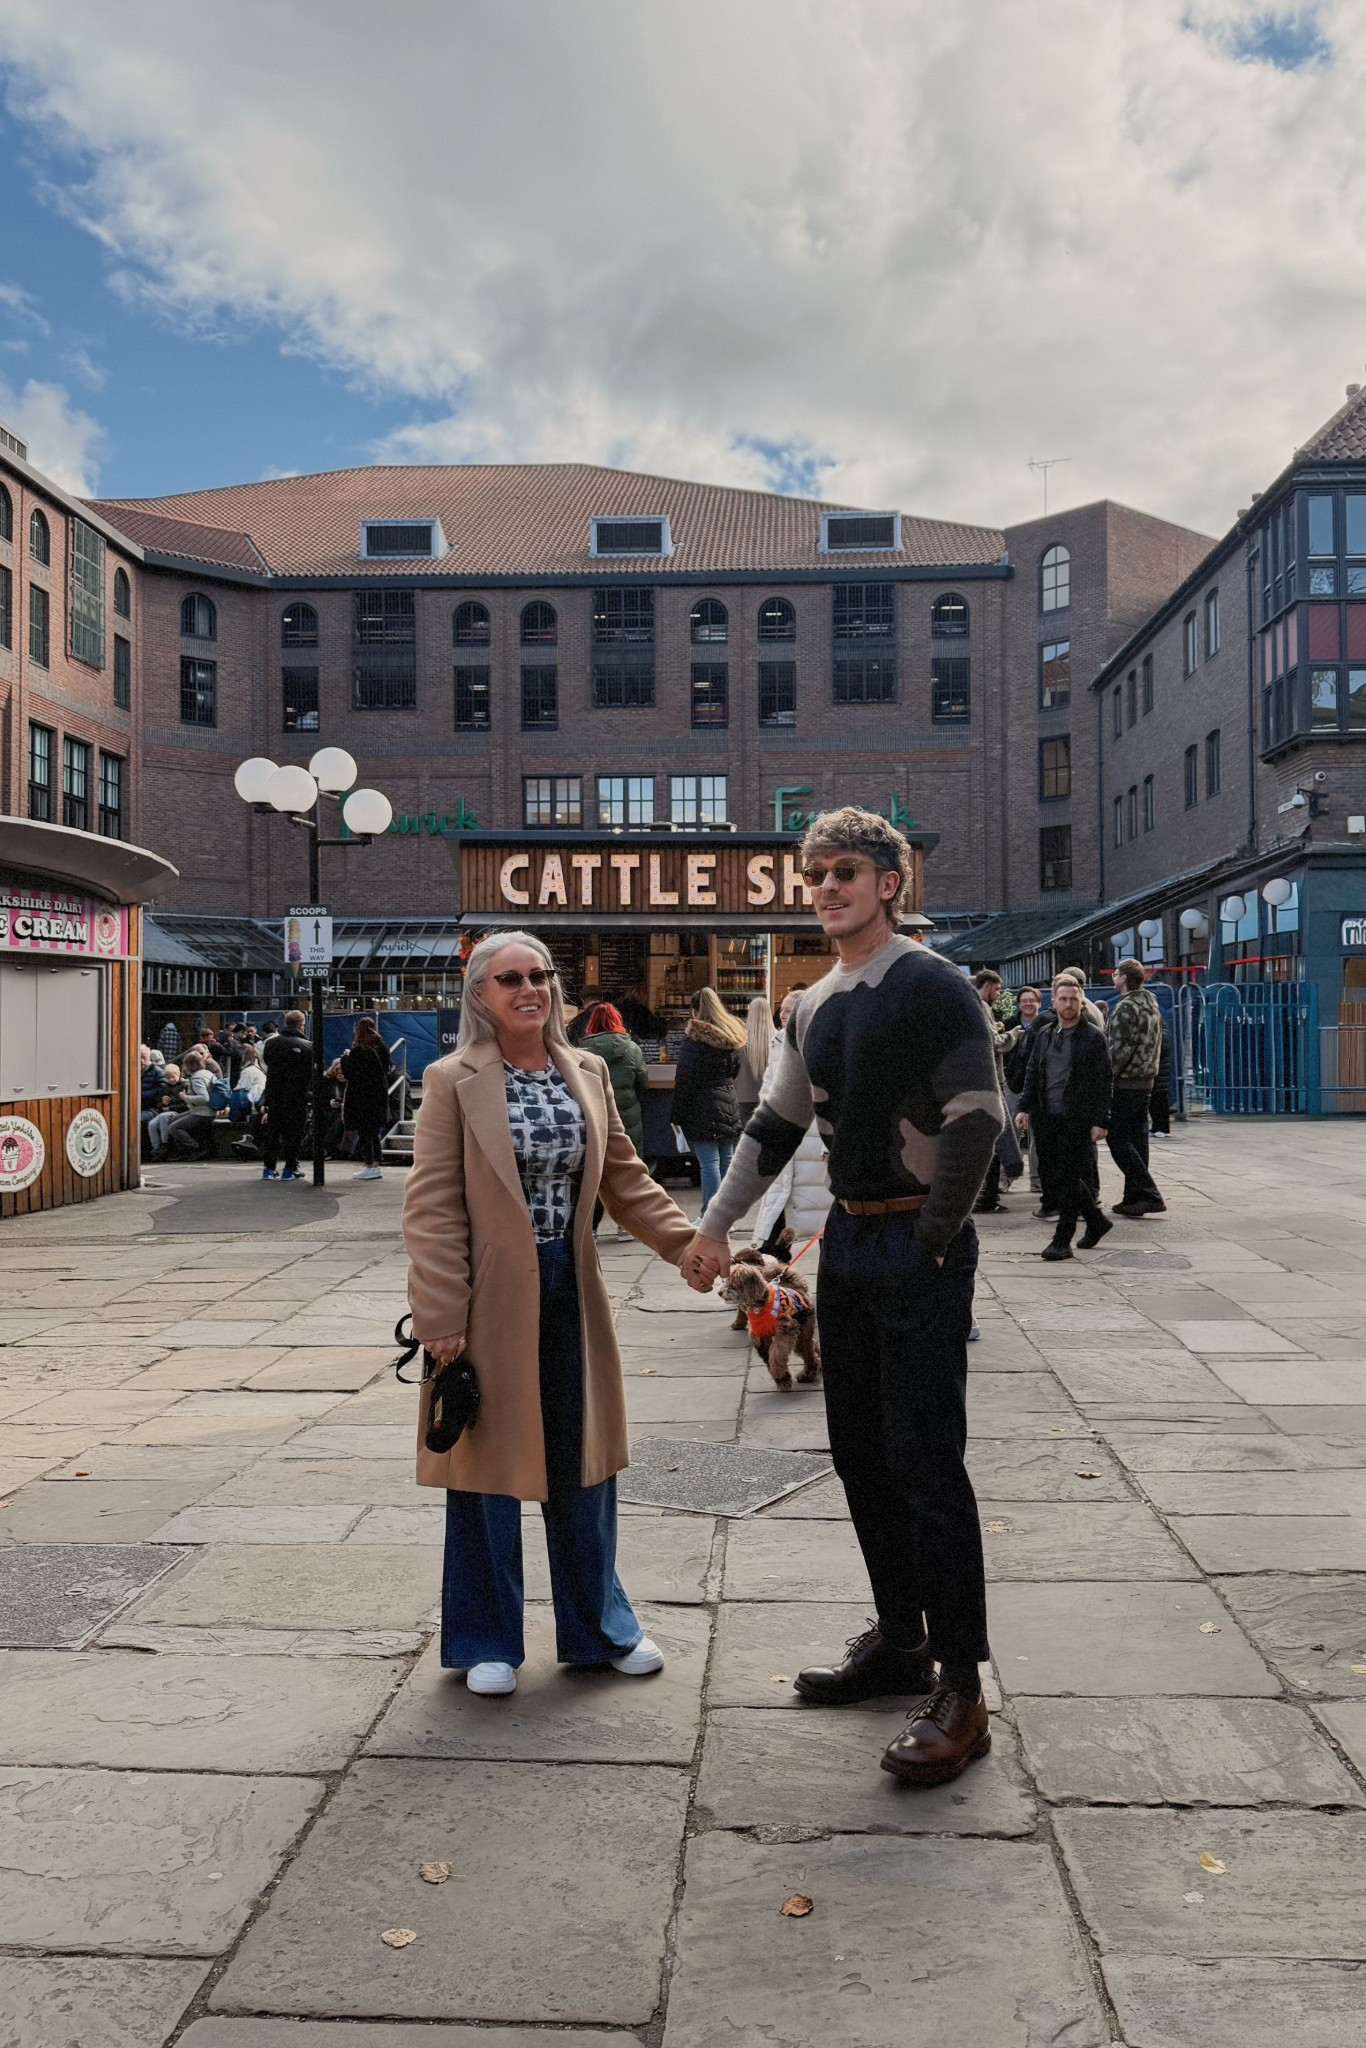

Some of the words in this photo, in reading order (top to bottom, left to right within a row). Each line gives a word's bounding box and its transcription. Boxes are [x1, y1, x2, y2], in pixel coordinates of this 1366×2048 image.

[499, 853, 717, 905] CATTLE
[0, 895, 52, 911] KSHIRE
[54, 900, 84, 915] DAIRY
[289, 907, 328, 915] SCOOPS
[14, 915, 88, 943] CREAM
[302, 968, 329, 977] £3.00
